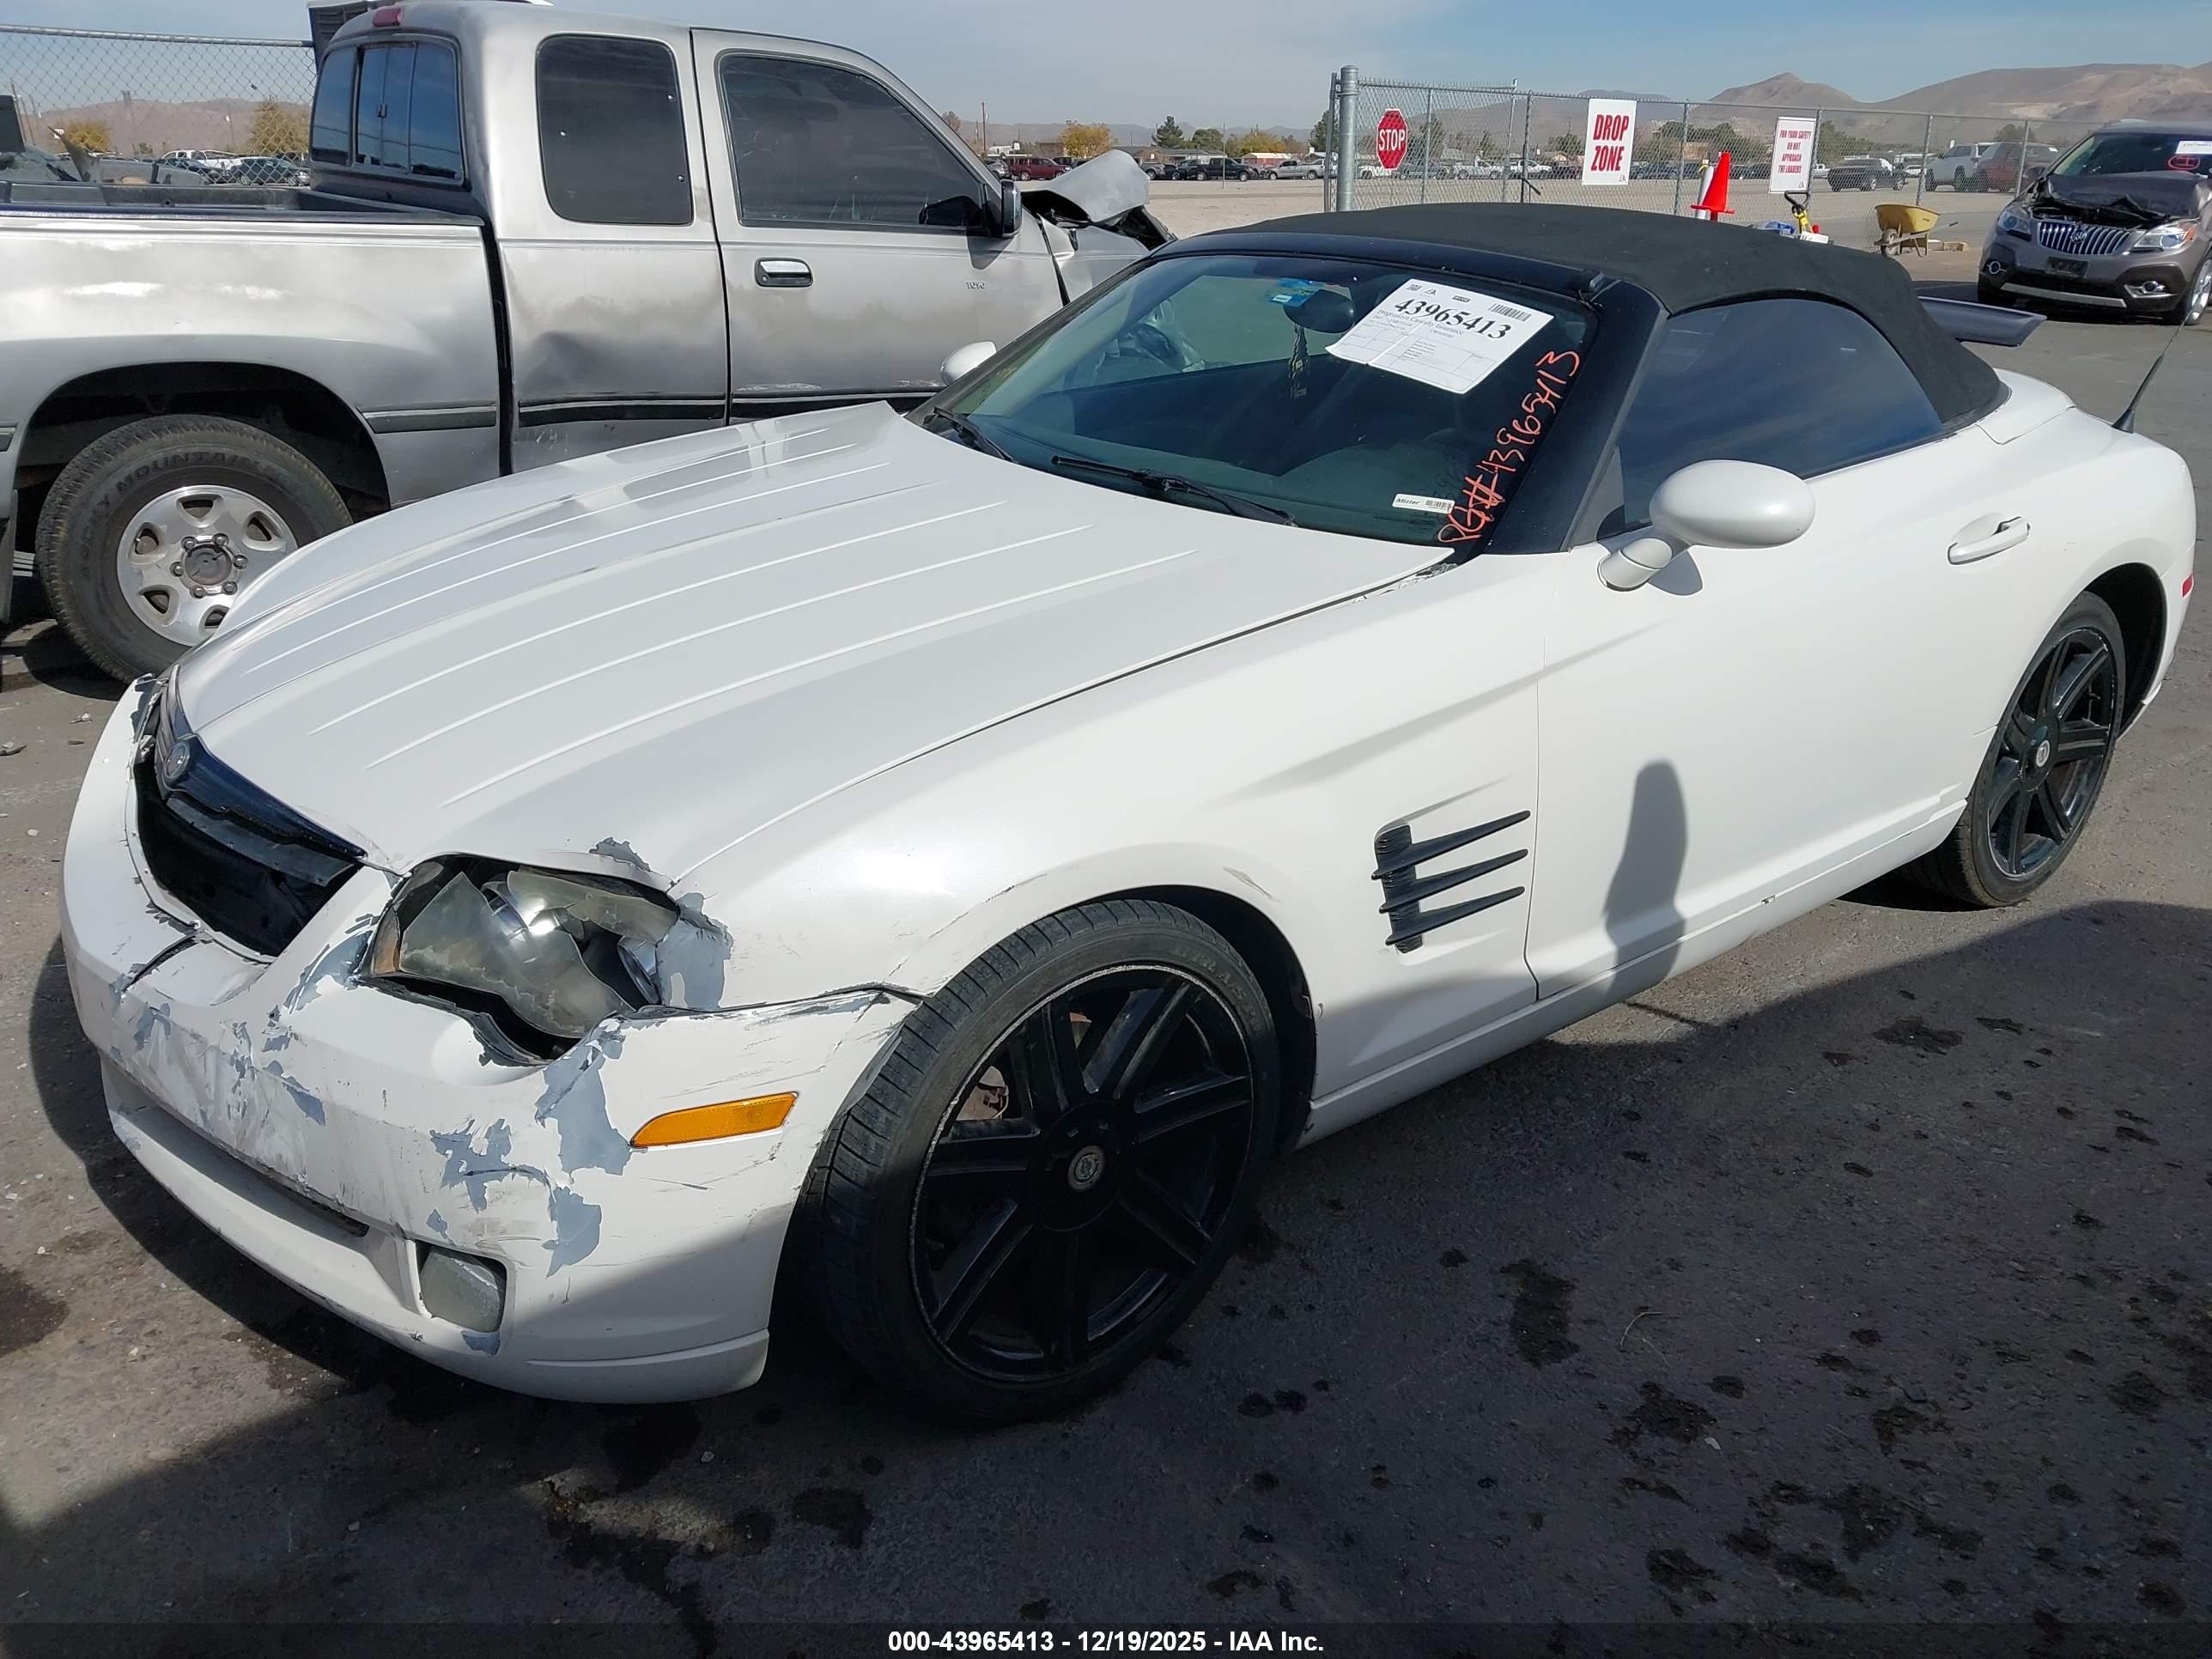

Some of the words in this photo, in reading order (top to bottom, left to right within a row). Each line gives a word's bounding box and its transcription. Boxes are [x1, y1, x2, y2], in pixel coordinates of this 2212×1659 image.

[1593, 114, 1630, 141] DROP
[1788, 131, 1798, 139] YOUR
[1798, 131, 1811, 139] SAFETY
[1379, 129, 1406, 151] STOP
[1590, 145, 1625, 172] ZONE
[1395, 298, 1512, 339] 43965413
[1435, 323, 1464, 336] Insurance
